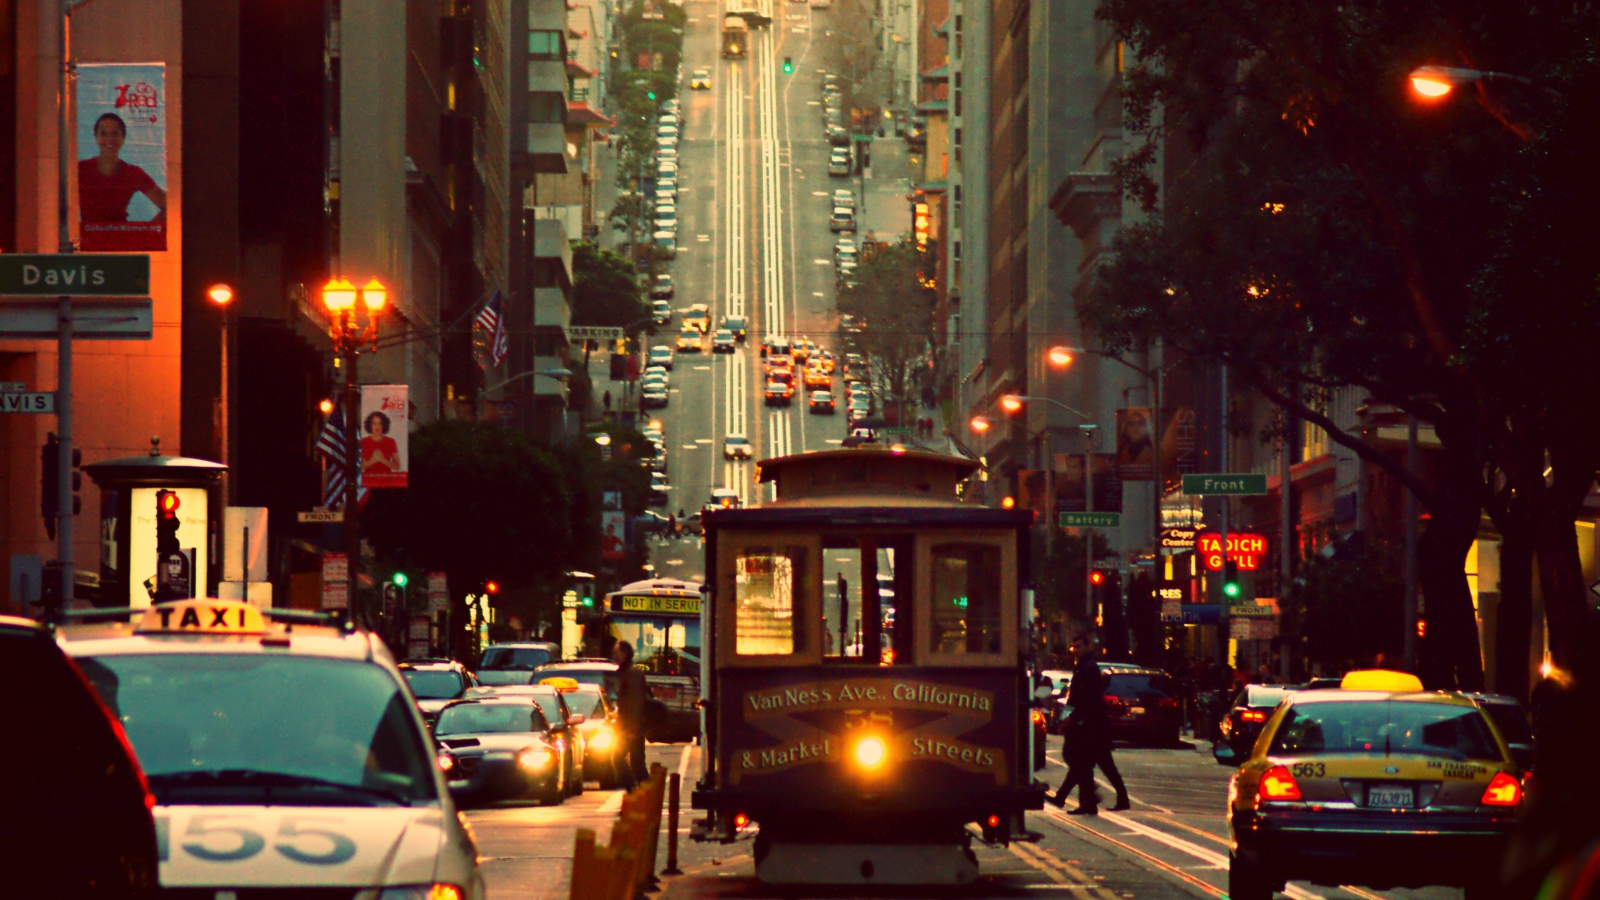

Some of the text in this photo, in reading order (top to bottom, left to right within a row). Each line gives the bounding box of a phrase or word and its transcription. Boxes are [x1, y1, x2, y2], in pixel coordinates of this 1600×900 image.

[129, 90, 158, 109] Red
[22, 264, 106, 286] Davis
[1204, 479, 1245, 490] Front
[304, 512, 337, 521] FRONT
[1066, 515, 1113, 525] Battery
[1170, 529, 1196, 540] Copy
[1162, 538, 1196, 547] Center
[624, 597, 645, 608] NOT
[649, 600, 661, 609] IN
[1235, 606, 1266, 615] FRONT
[155, 606, 246, 629] TAXI
[749, 694, 783, 711] Van
[784, 688, 832, 706] Ness
[892, 683, 990, 711] California
[742, 737, 995, 768] & Market Streets
[1292, 762, 1326, 778] 563
[1426, 761, 1443, 769] SAN
